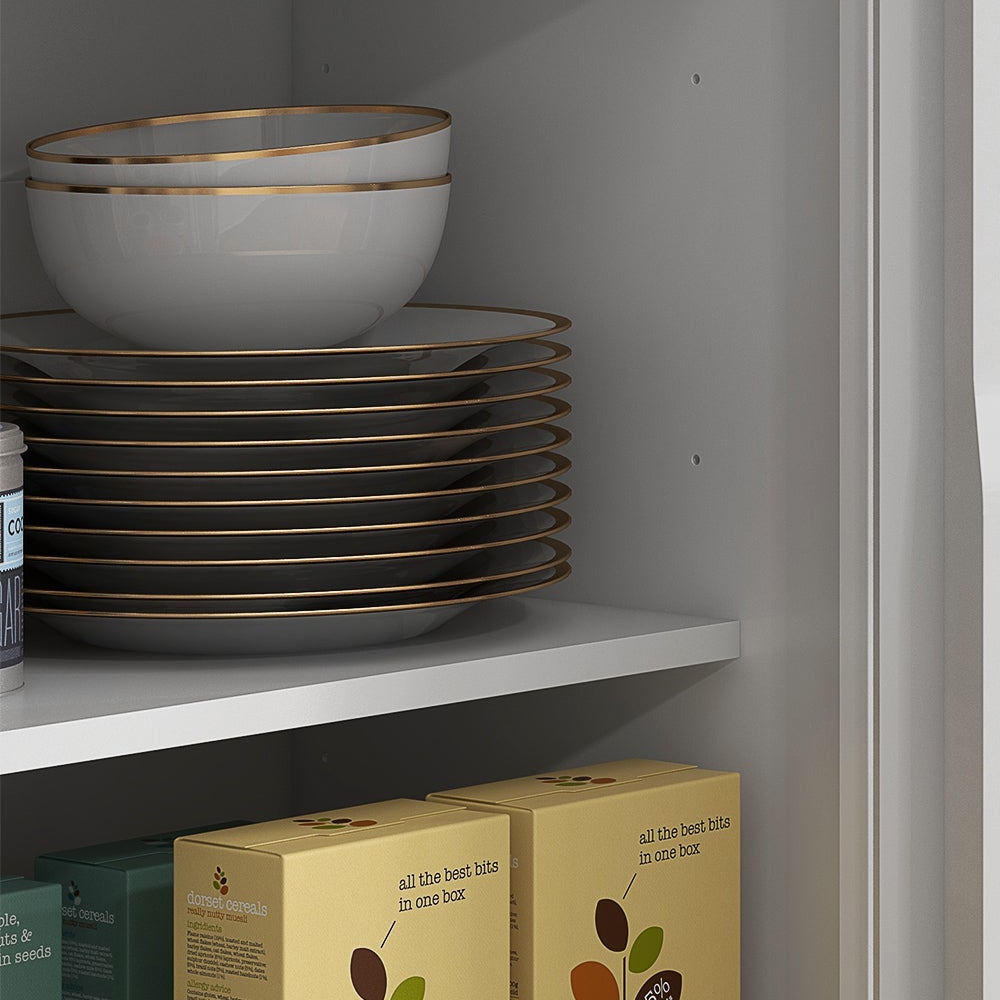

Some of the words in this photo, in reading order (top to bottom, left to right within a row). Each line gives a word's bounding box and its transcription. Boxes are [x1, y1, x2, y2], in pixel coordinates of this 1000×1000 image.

[639, 829, 655, 845] all
[657, 825, 678, 842] the
[681, 819, 706, 838] best
[708, 815, 731, 831] bits
[639, 851, 652, 866] in
[654, 848, 677, 863] one
[679, 841, 701, 858] box
[398, 873, 416, 891] all
[419, 870, 442, 888] the
[444, 863, 472, 882] best
[474, 859, 499, 876] bits
[187, 891, 224, 909] dorset
[226, 900, 268, 917] cereals
[398, 896, 413, 913] in
[416, 894, 440, 910] one
[442, 887, 466, 904] box
[79, 909, 115, 924] cereals
[21, 928, 33, 943] &
[15, 945, 52, 964] seeds
